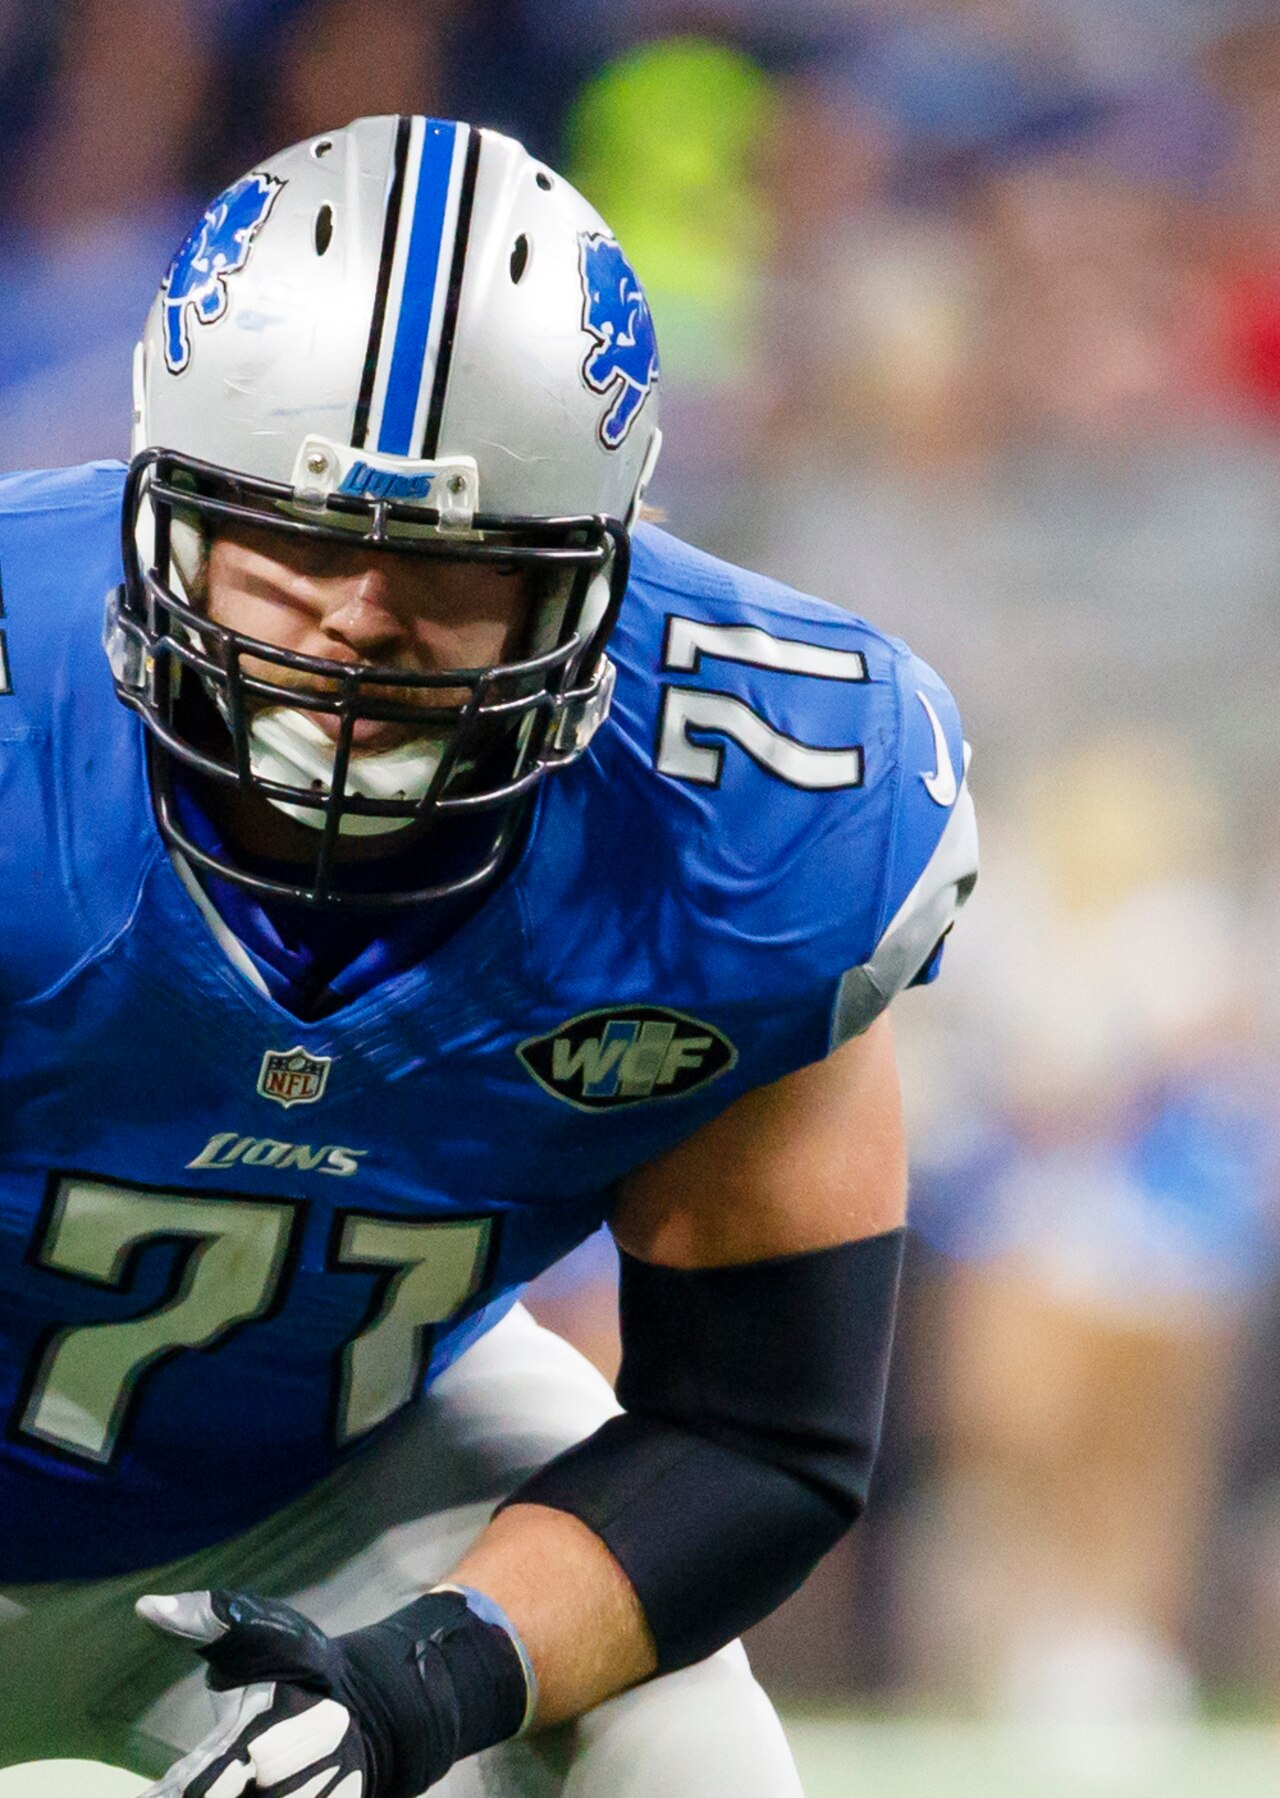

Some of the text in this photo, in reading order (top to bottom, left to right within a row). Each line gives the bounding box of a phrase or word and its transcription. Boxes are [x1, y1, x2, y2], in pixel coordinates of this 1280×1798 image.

[654, 612, 870, 793] 71
[268, 1071, 316, 1097] NFL
[552, 1036, 714, 1085] WCF
[184, 1131, 369, 1177] LIONS
[7, 1169, 506, 1468] 71
